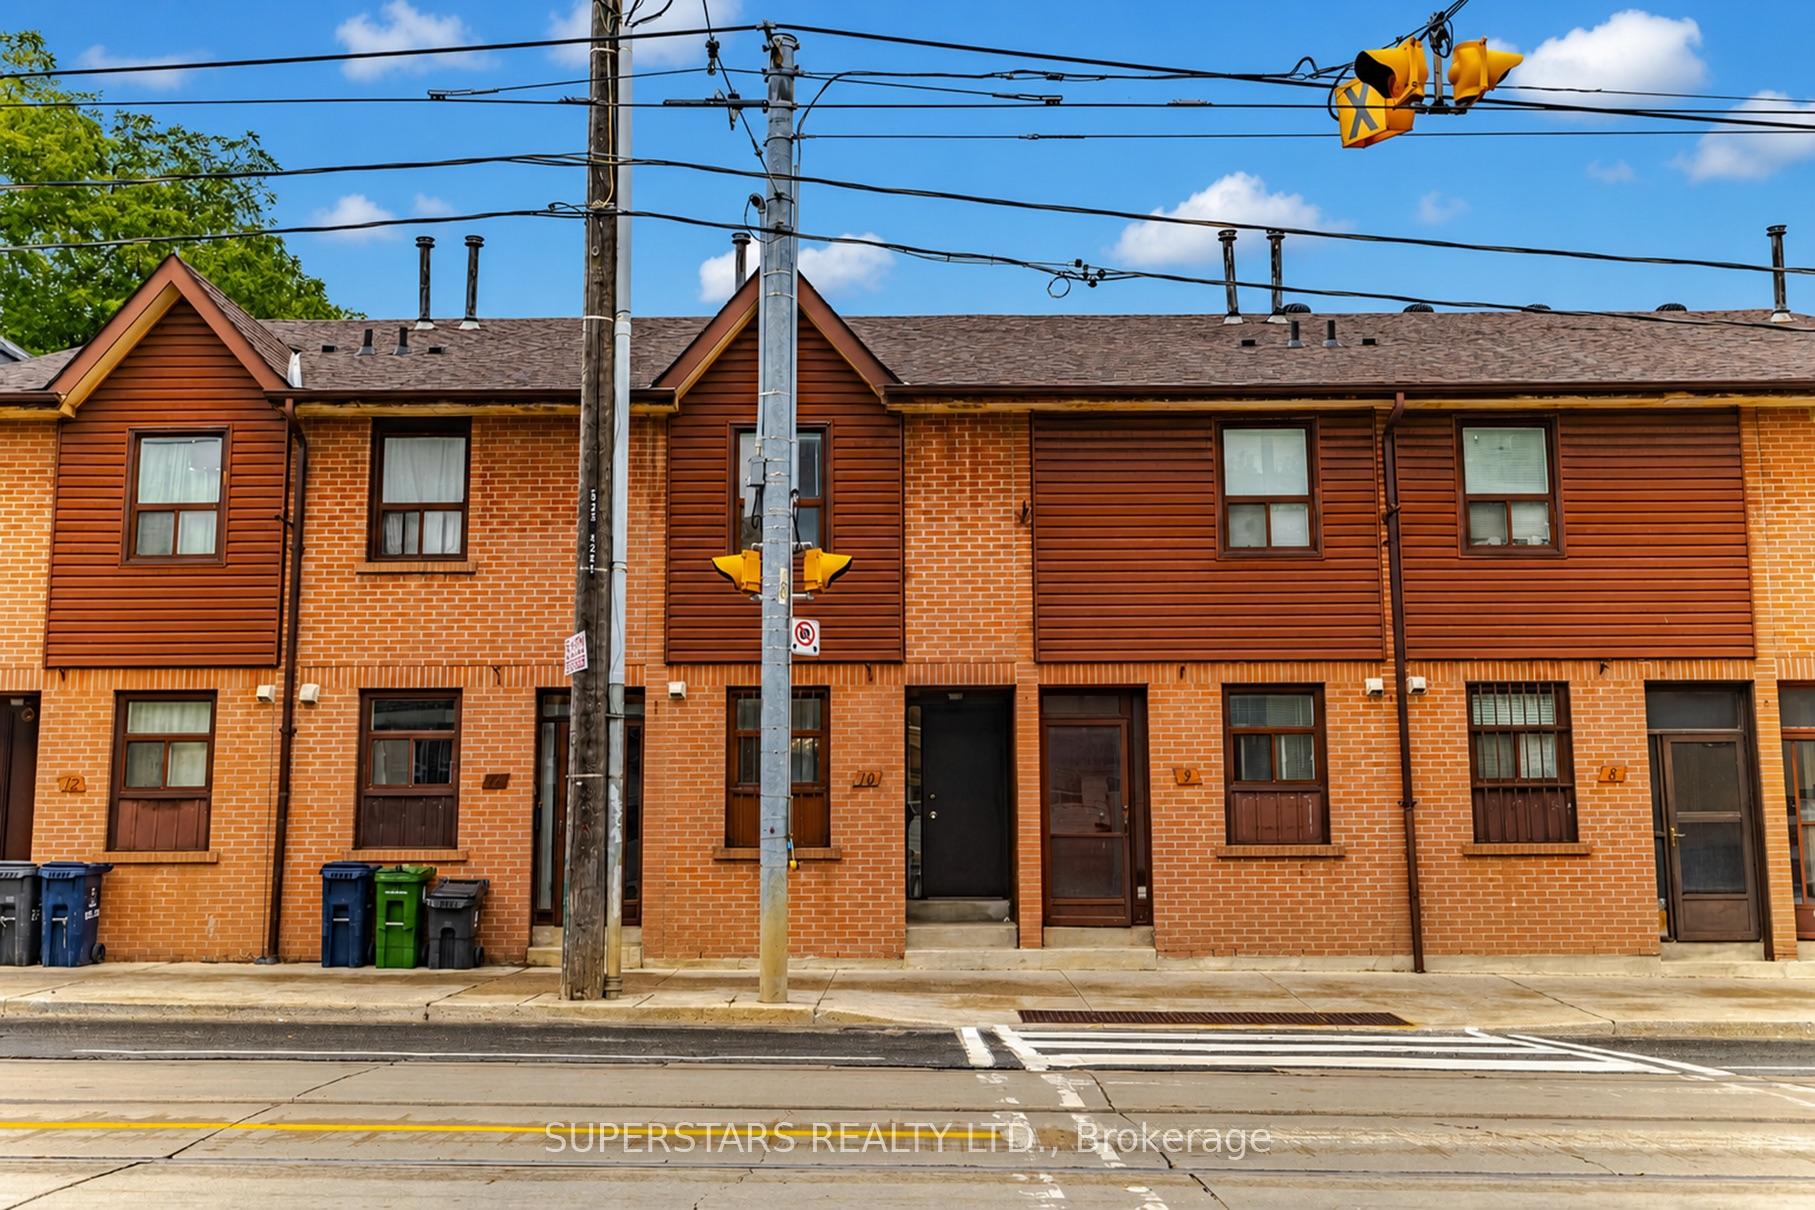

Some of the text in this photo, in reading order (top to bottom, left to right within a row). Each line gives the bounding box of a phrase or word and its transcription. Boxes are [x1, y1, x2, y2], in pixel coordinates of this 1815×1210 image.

[1344, 83, 1378, 139] X
[65, 777, 80, 791] 12
[860, 772, 875, 785] 10
